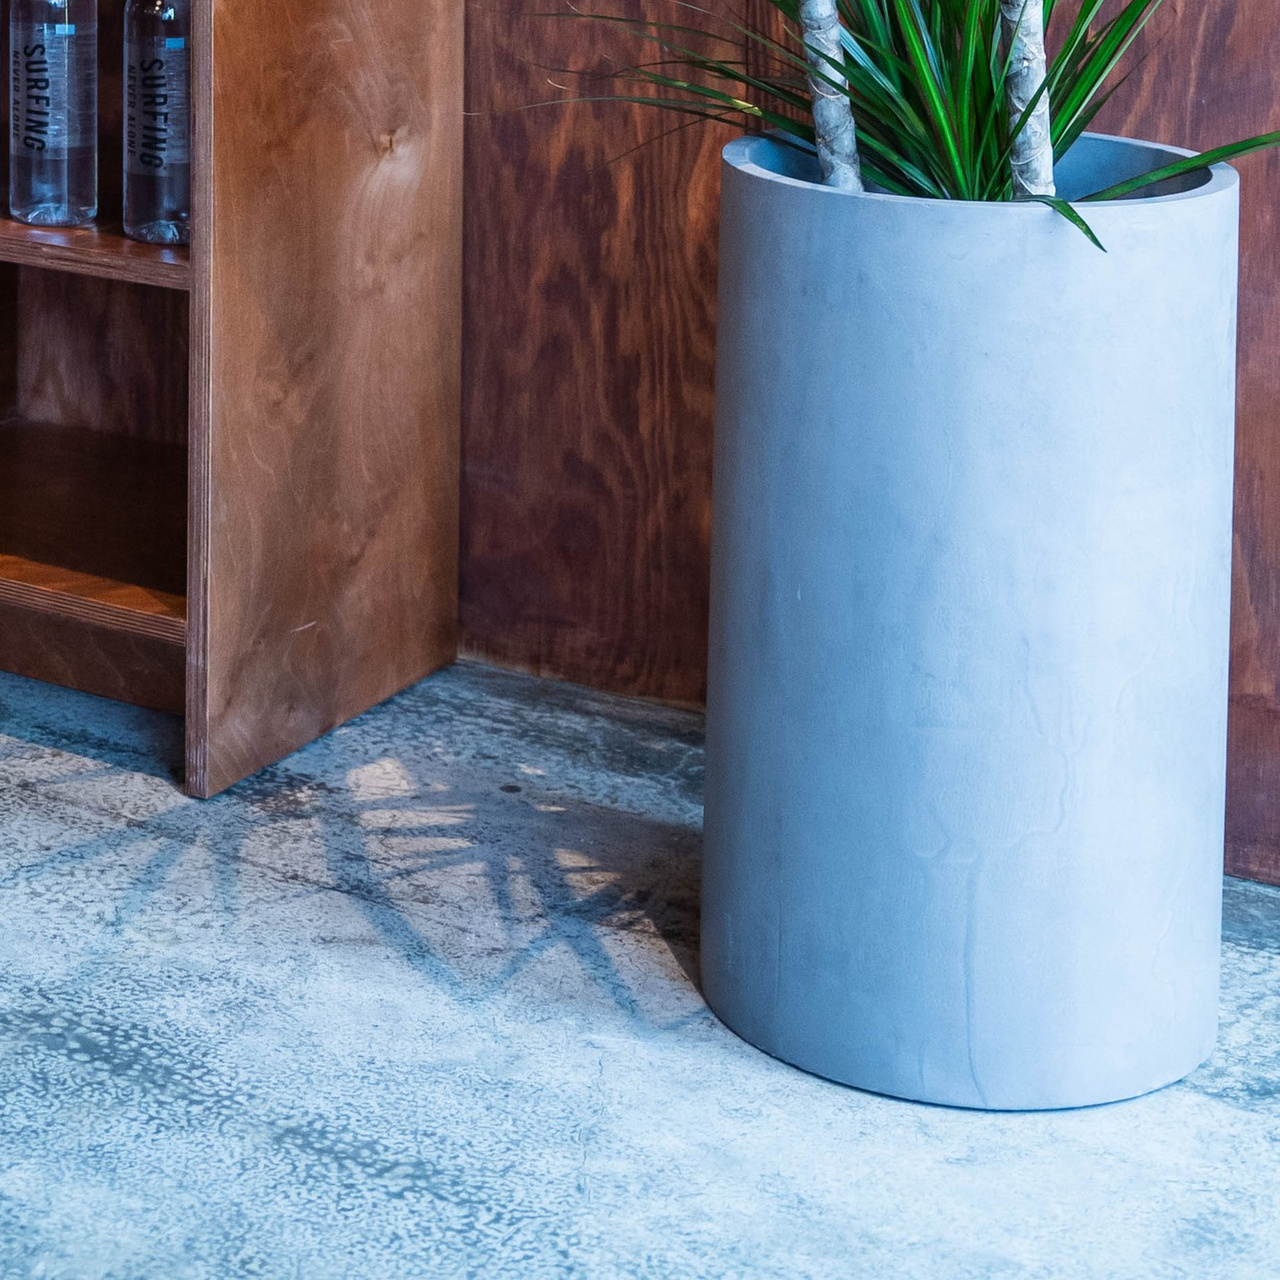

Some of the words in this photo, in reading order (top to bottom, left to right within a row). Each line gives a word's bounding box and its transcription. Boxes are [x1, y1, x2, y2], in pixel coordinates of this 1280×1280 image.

[12, 50, 20, 91] NEVER
[127, 65, 136, 108] NEVER
[12, 98, 20, 138] ALONE
[23, 44, 50, 153] SURFING
[139, 58, 169, 169] SURFING
[127, 115, 136, 156] ALONE
